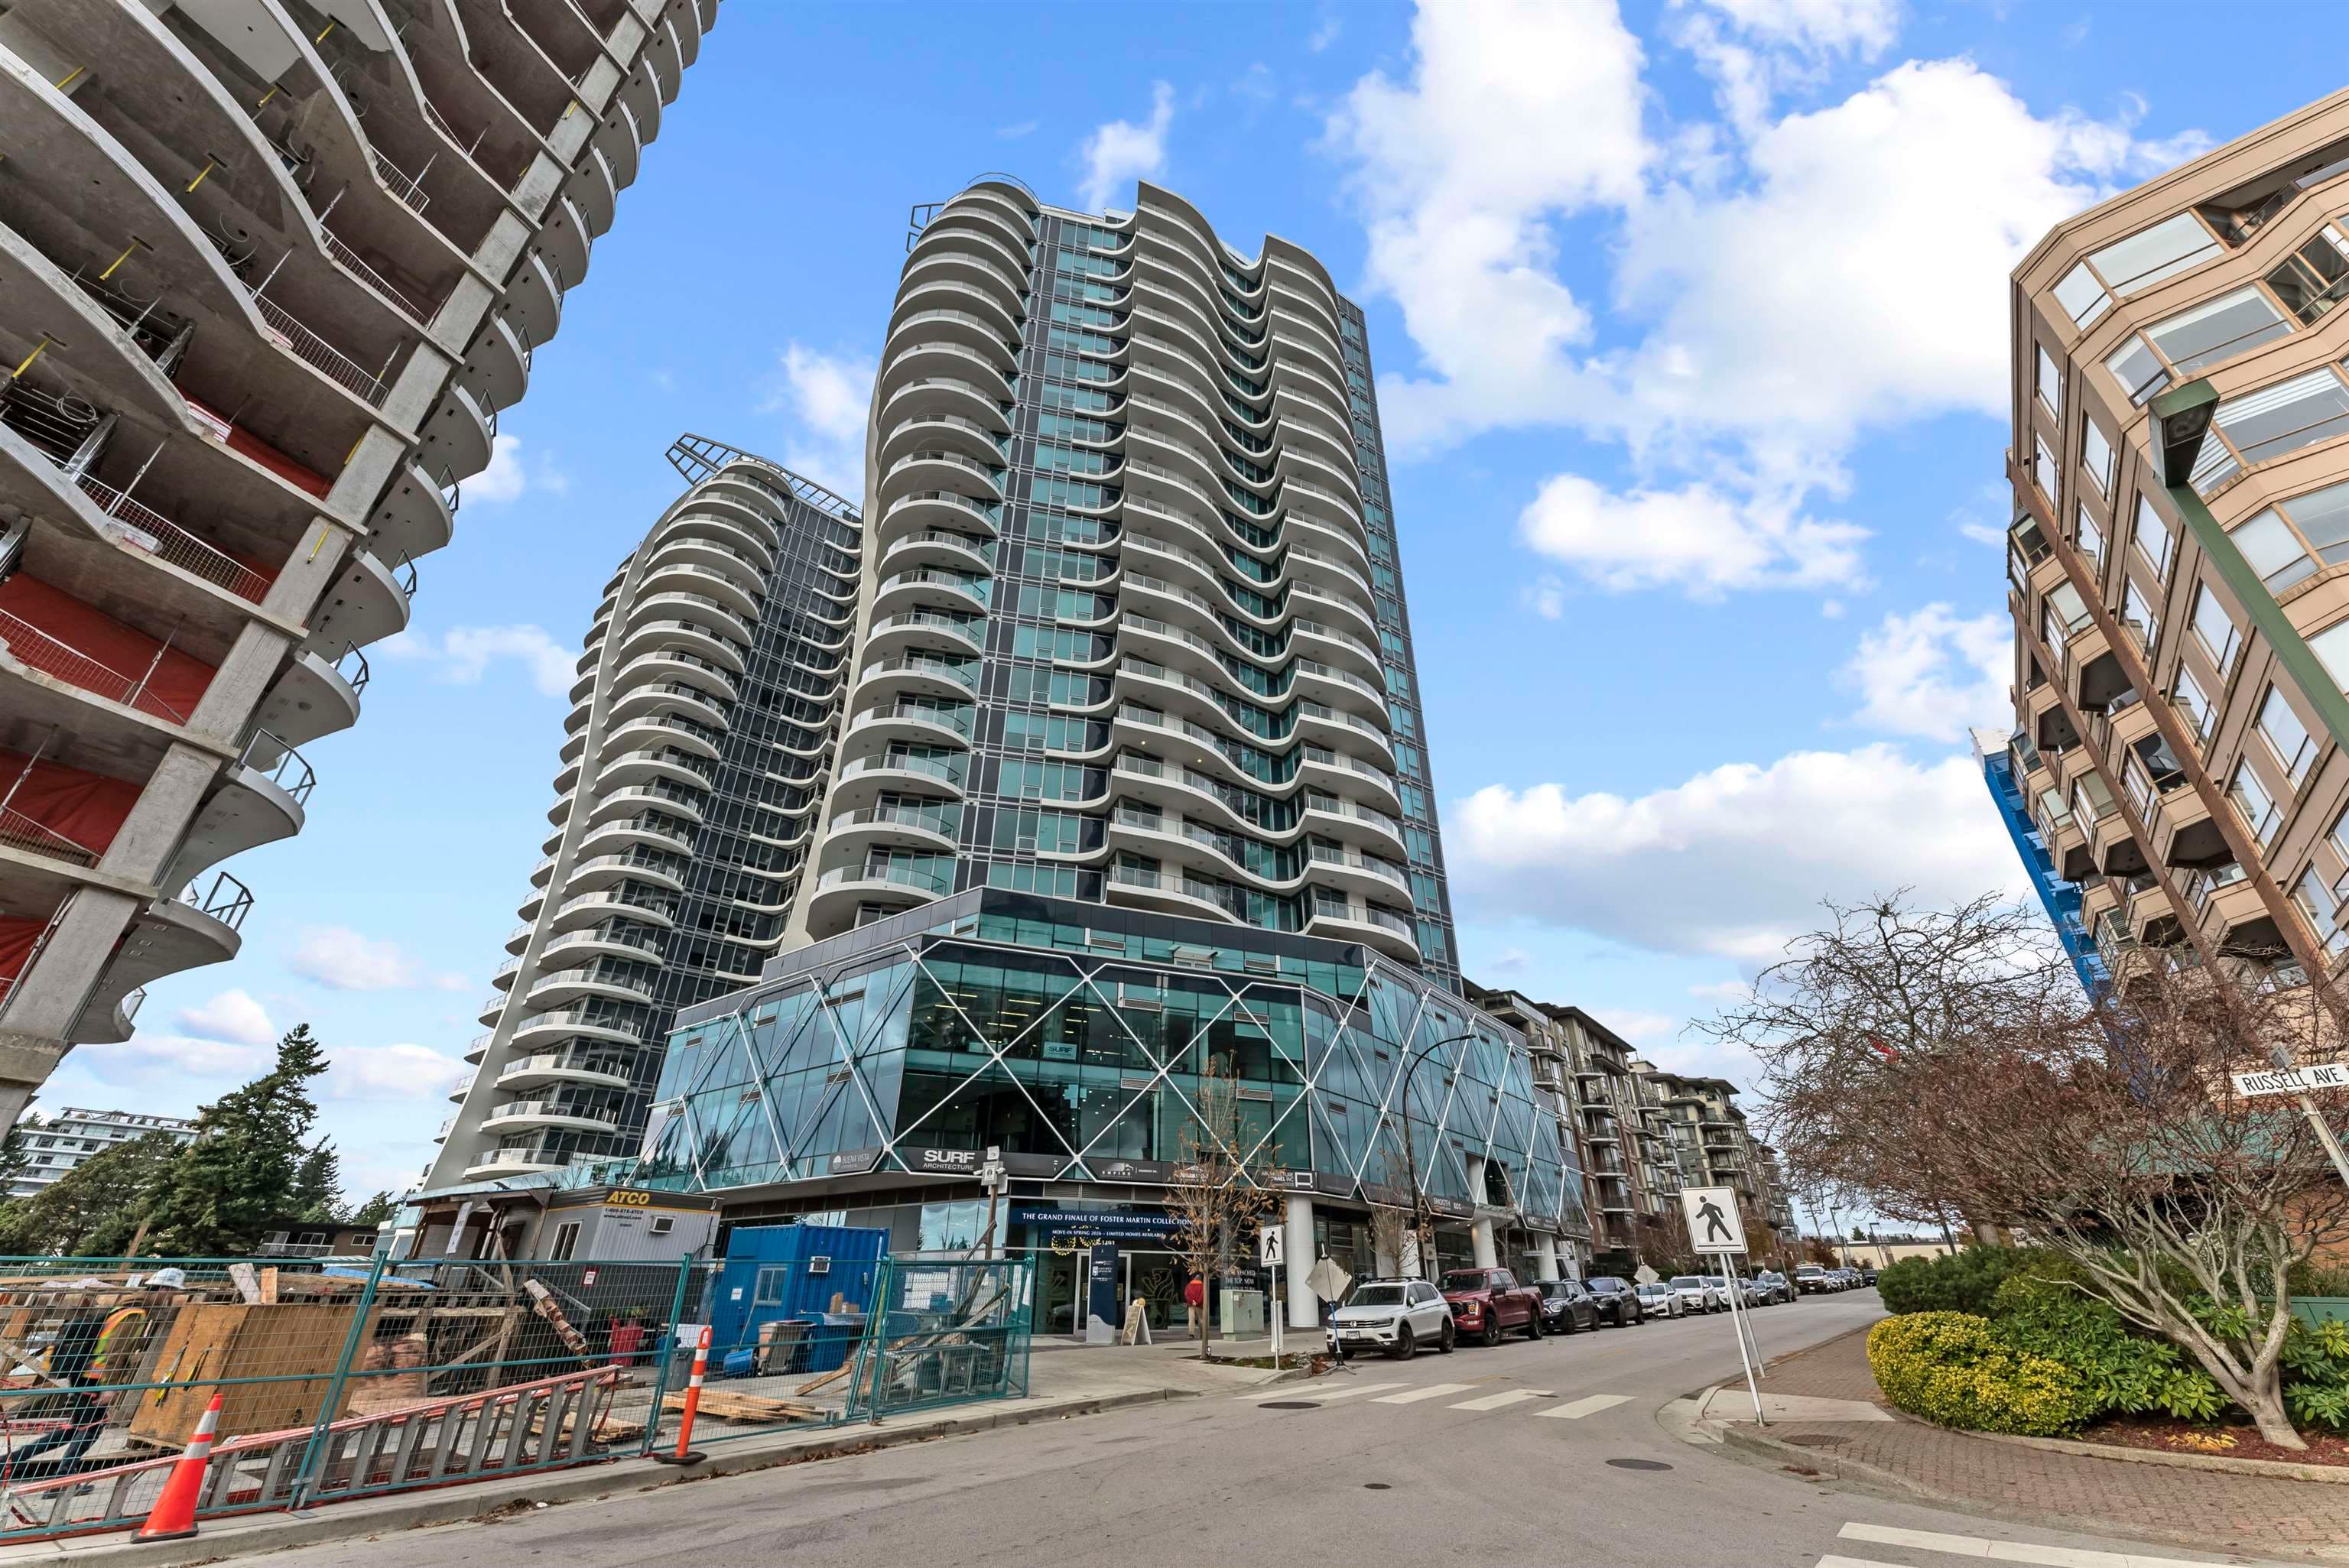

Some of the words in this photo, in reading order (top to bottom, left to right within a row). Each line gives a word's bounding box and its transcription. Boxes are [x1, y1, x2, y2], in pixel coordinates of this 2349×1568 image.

[2242, 1072, 2311, 1092] RUSSELL
[2313, 1067, 2343, 1085] AVE
[842, 1155, 857, 1164] BUENA
[857, 1154, 869, 1162] VISTA
[924, 1150, 975, 1163] SURF
[606, 1190, 650, 1205] ATCO
